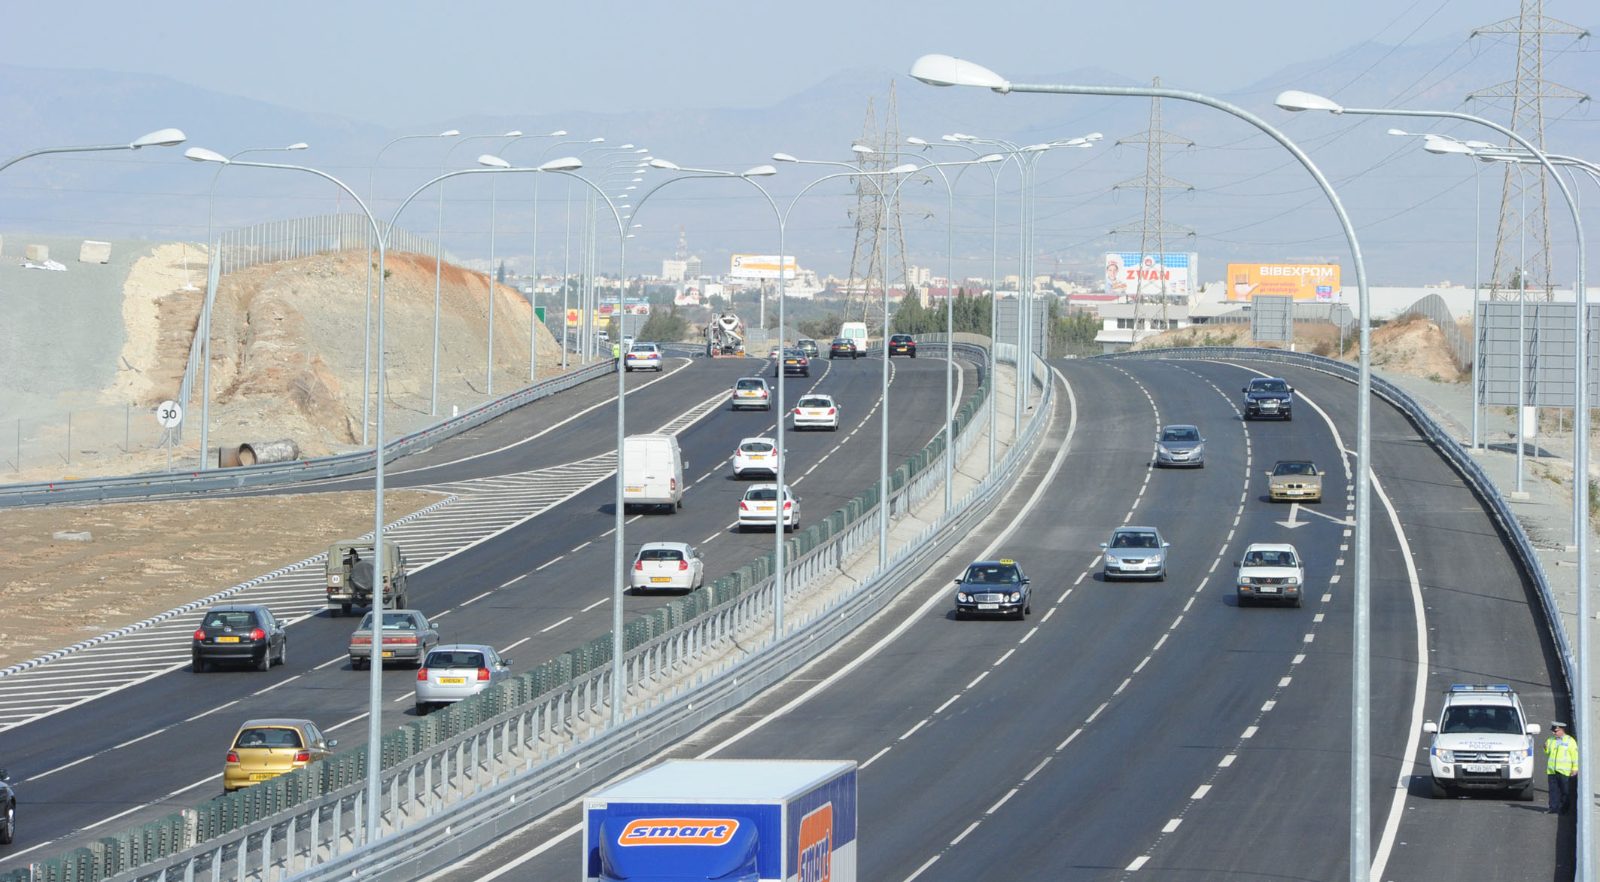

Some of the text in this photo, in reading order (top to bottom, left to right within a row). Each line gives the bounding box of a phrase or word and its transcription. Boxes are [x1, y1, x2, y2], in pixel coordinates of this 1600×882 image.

[1126, 270, 1170, 281] ZWAN
[162, 409, 177, 419] 30
[626, 825, 727, 838] smart
[800, 828, 829, 882] smart
